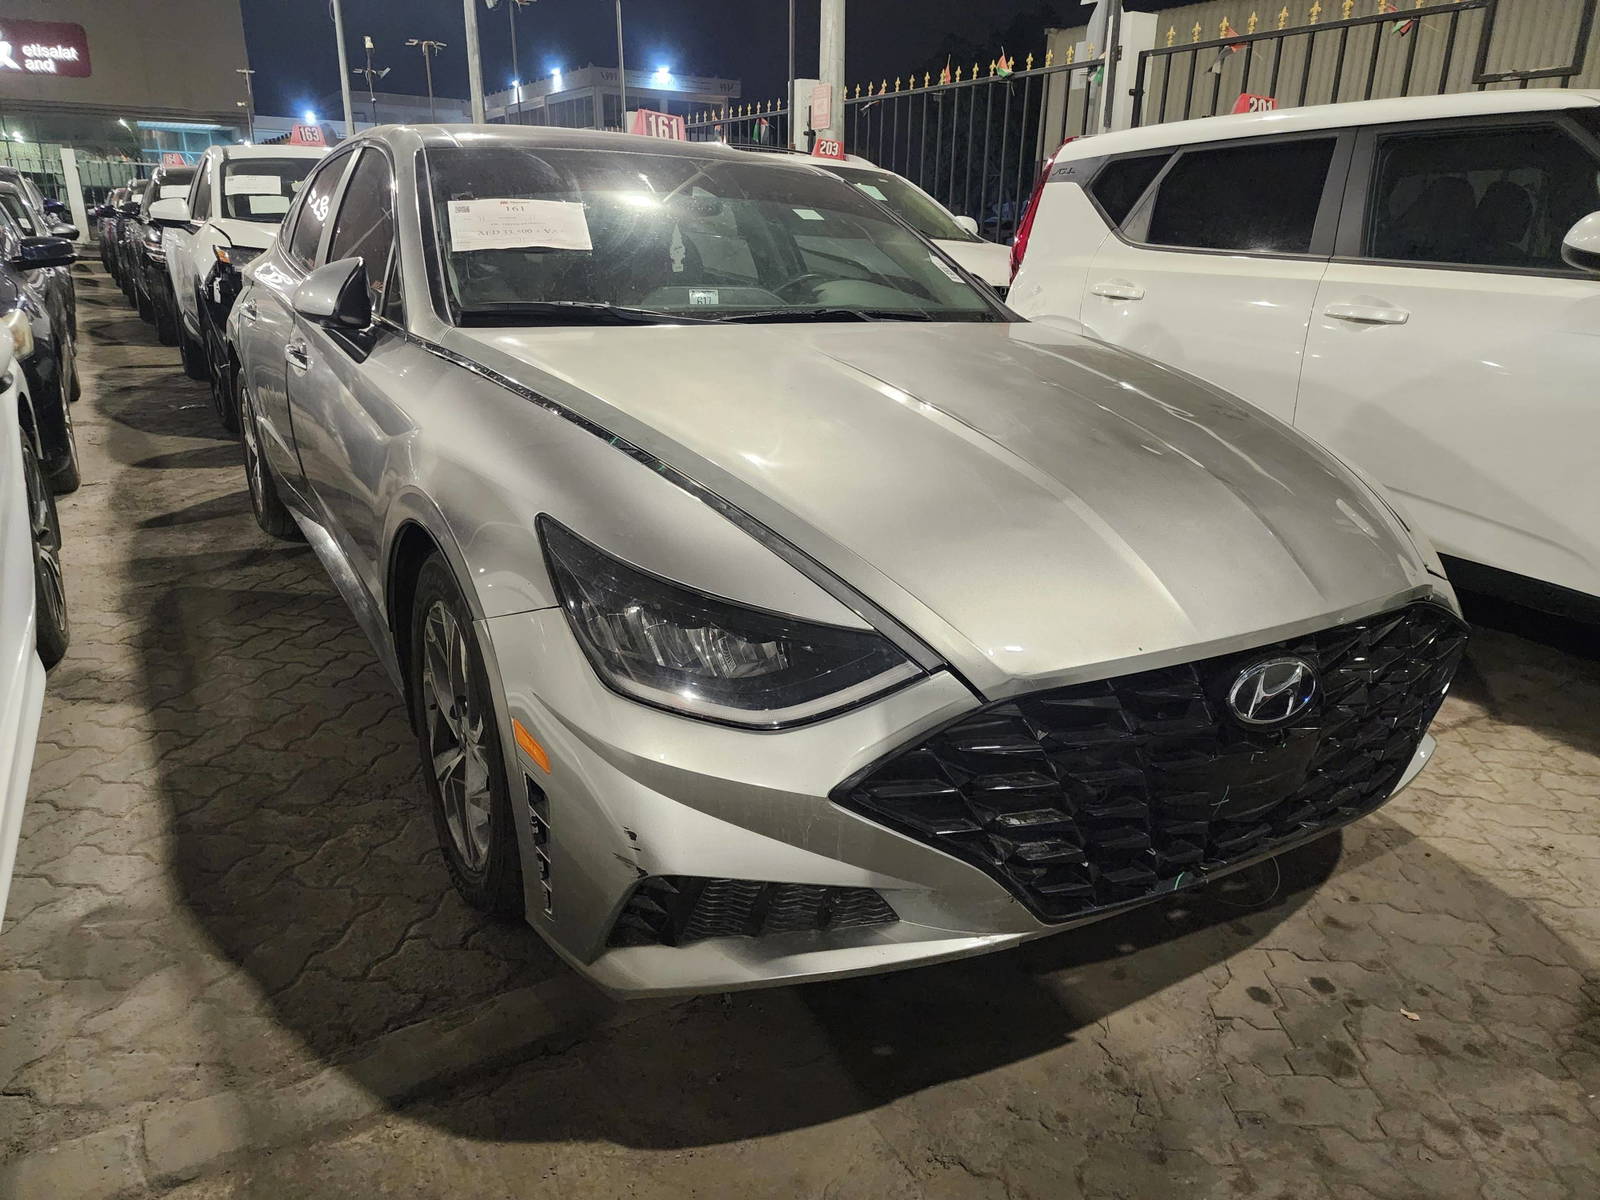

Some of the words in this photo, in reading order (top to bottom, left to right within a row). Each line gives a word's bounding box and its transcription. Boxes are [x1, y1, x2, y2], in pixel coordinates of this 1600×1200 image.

[1249, 96, 1273, 113] 201
[299, 126, 320, 142] 163
[648, 114, 679, 141] 161
[819, 140, 839, 156] 203
